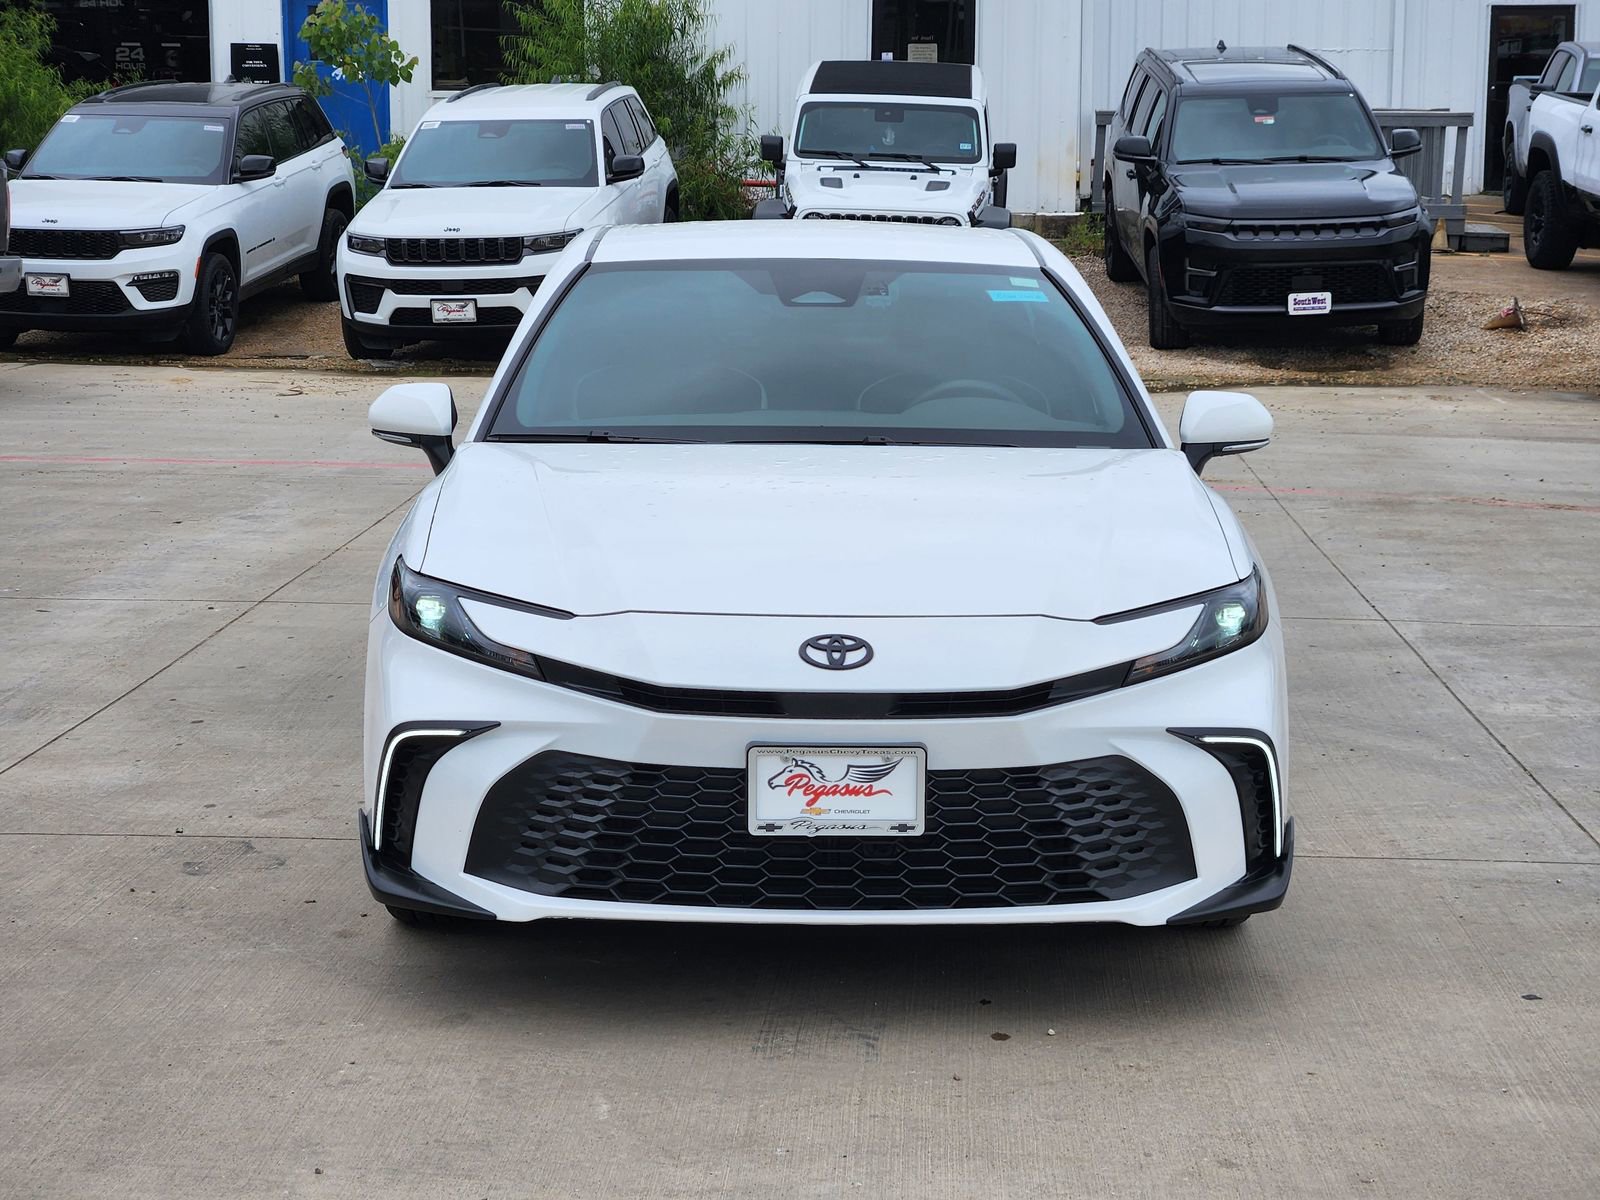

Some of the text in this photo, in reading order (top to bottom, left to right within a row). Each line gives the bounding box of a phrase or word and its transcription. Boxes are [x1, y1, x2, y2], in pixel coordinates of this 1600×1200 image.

[115, 47, 145, 61] 24
[115, 62, 146, 70] HOUR
[756, 748, 917, 756] www.PegasusChevyTexas.com
[784, 773, 893, 807] Pegasus
[790, 820, 885, 835] Pegasus
